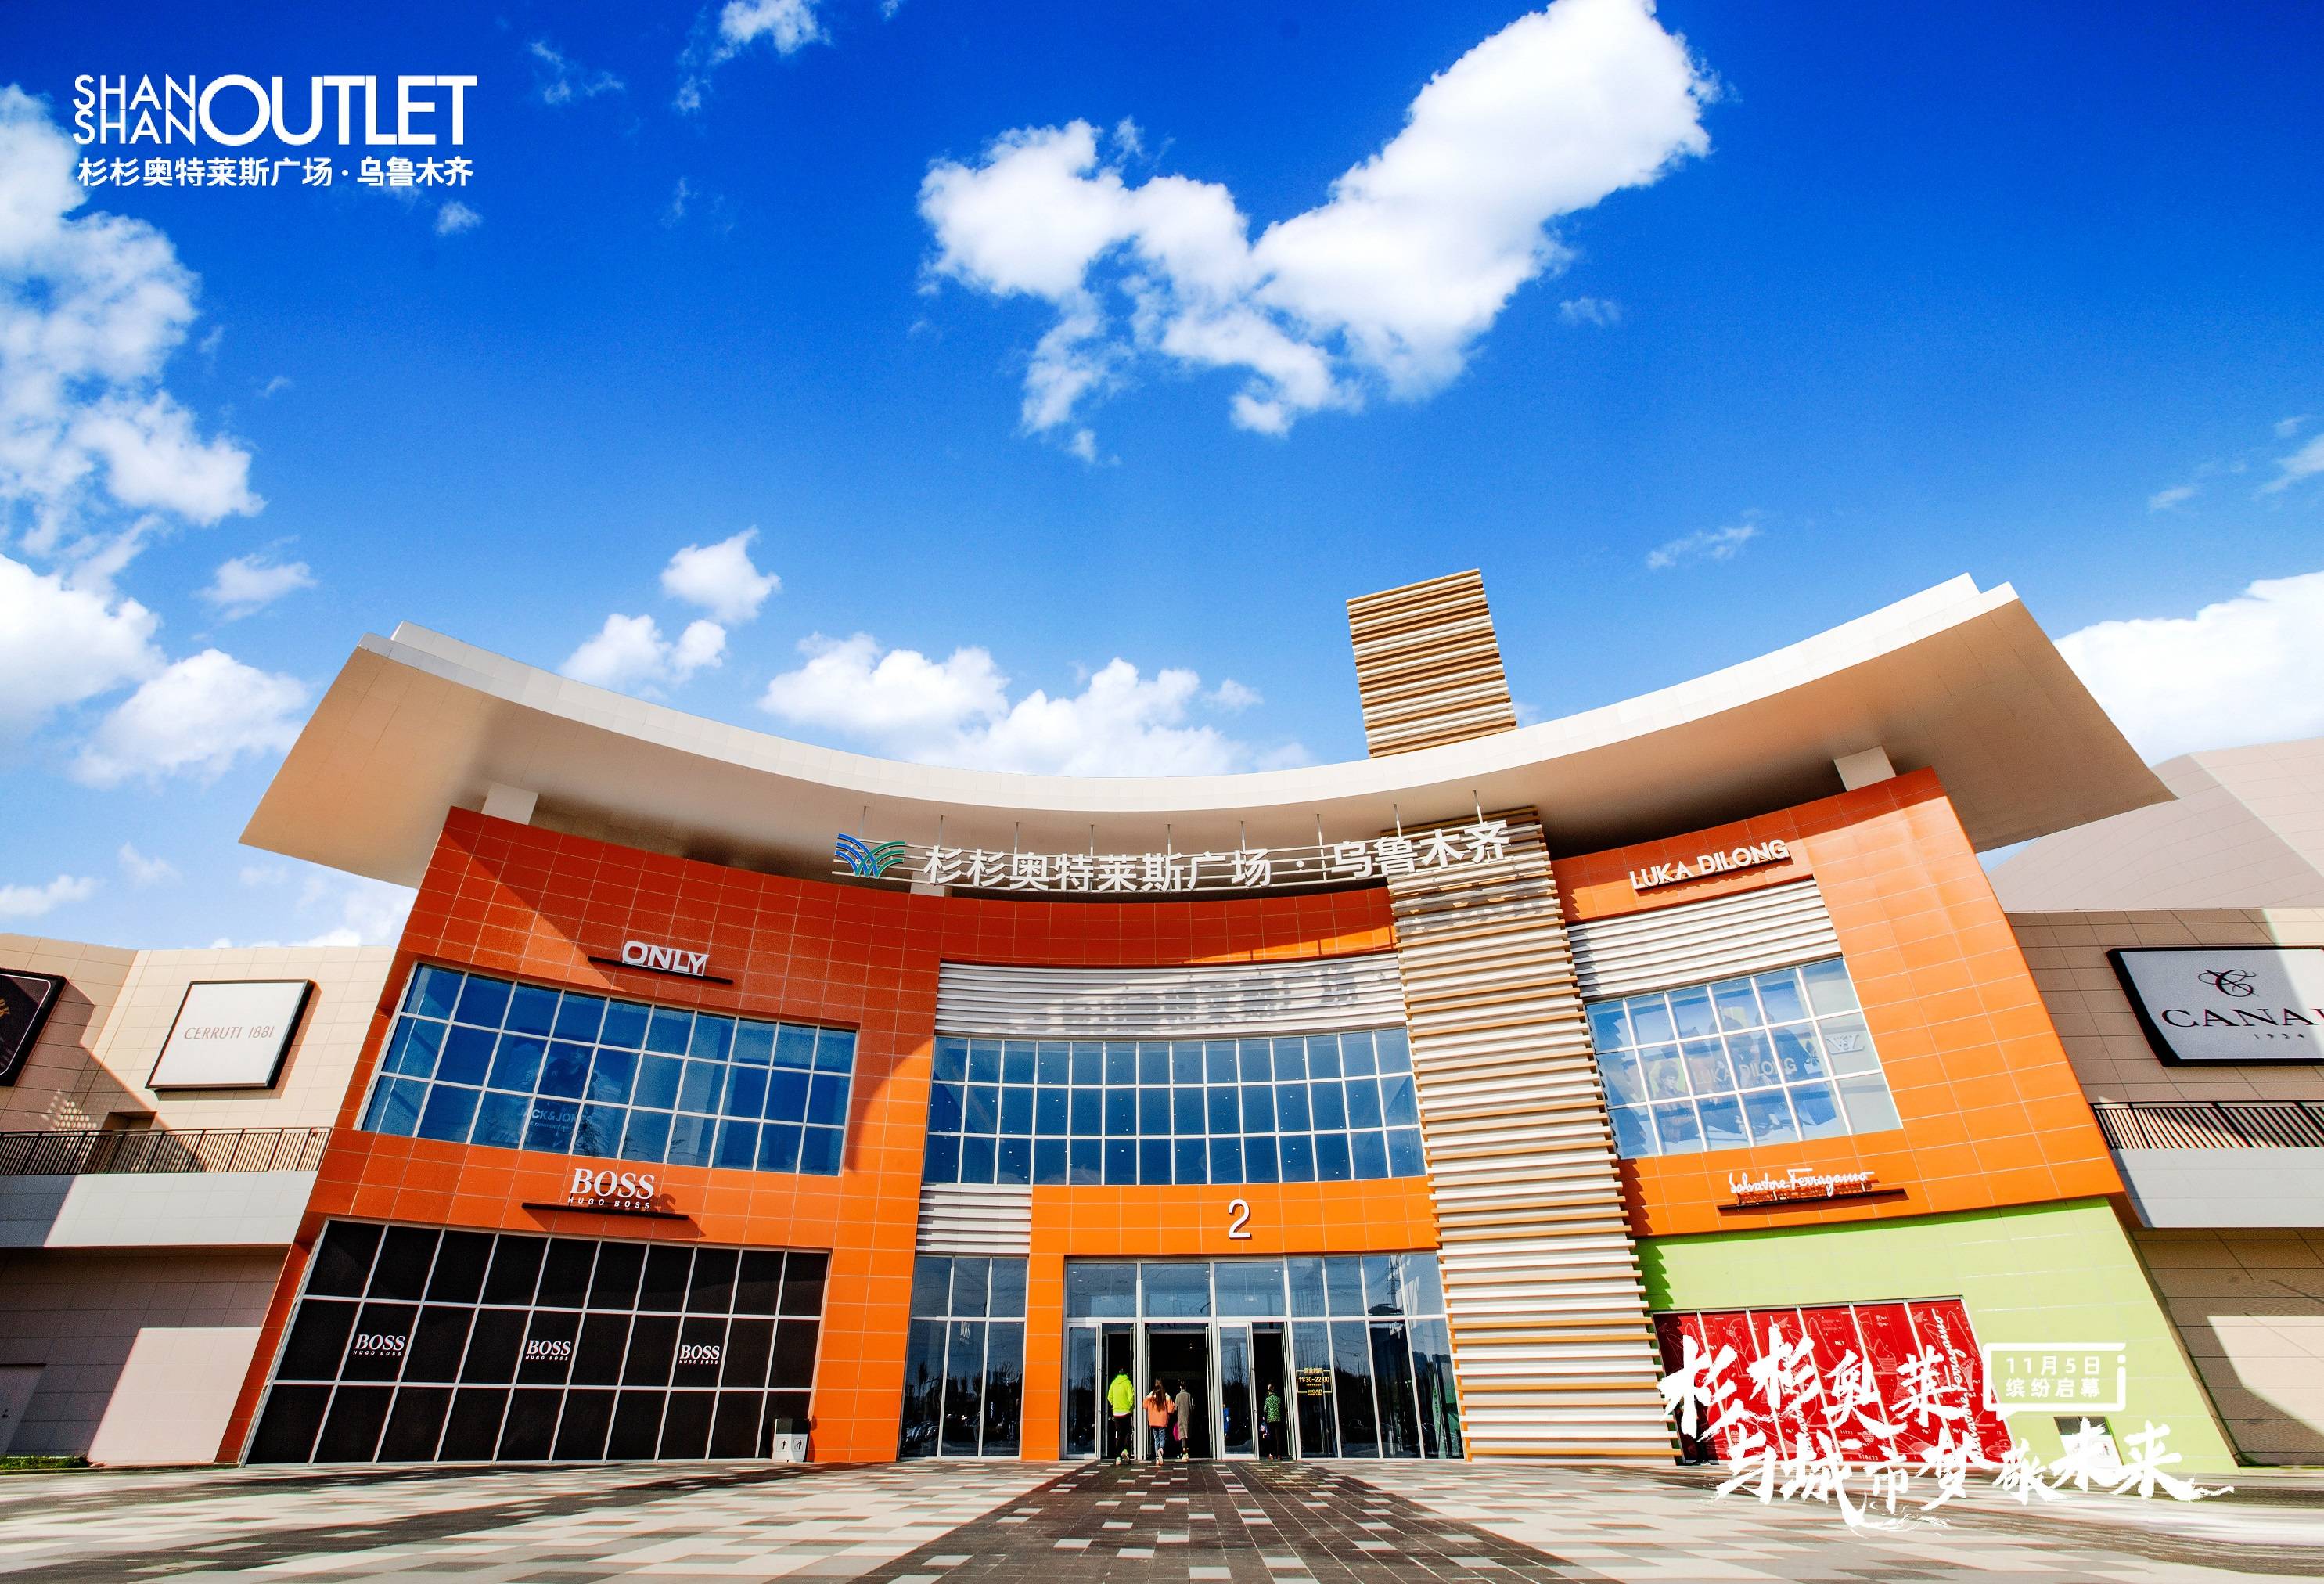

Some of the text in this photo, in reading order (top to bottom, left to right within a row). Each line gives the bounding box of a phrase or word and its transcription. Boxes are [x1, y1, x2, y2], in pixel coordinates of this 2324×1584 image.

[1629, 839, 1790, 890] LUKA DILONG
[622, 941, 710, 977] ONLY
[185, 1025, 275, 1039] CERRUTI 1881
[570, 1168, 655, 1199] BOSS
[1729, 1168, 1875, 1197] Salvatore Ferragamo
[567, 1197, 650, 1209] HUGO BOSS
[1229, 1199, 1251, 1238] 2
[354, 1334, 405, 1350] BOSS
[526, 1340, 571, 1355] BOSS
[679, 1345, 720, 1359] BOSS
